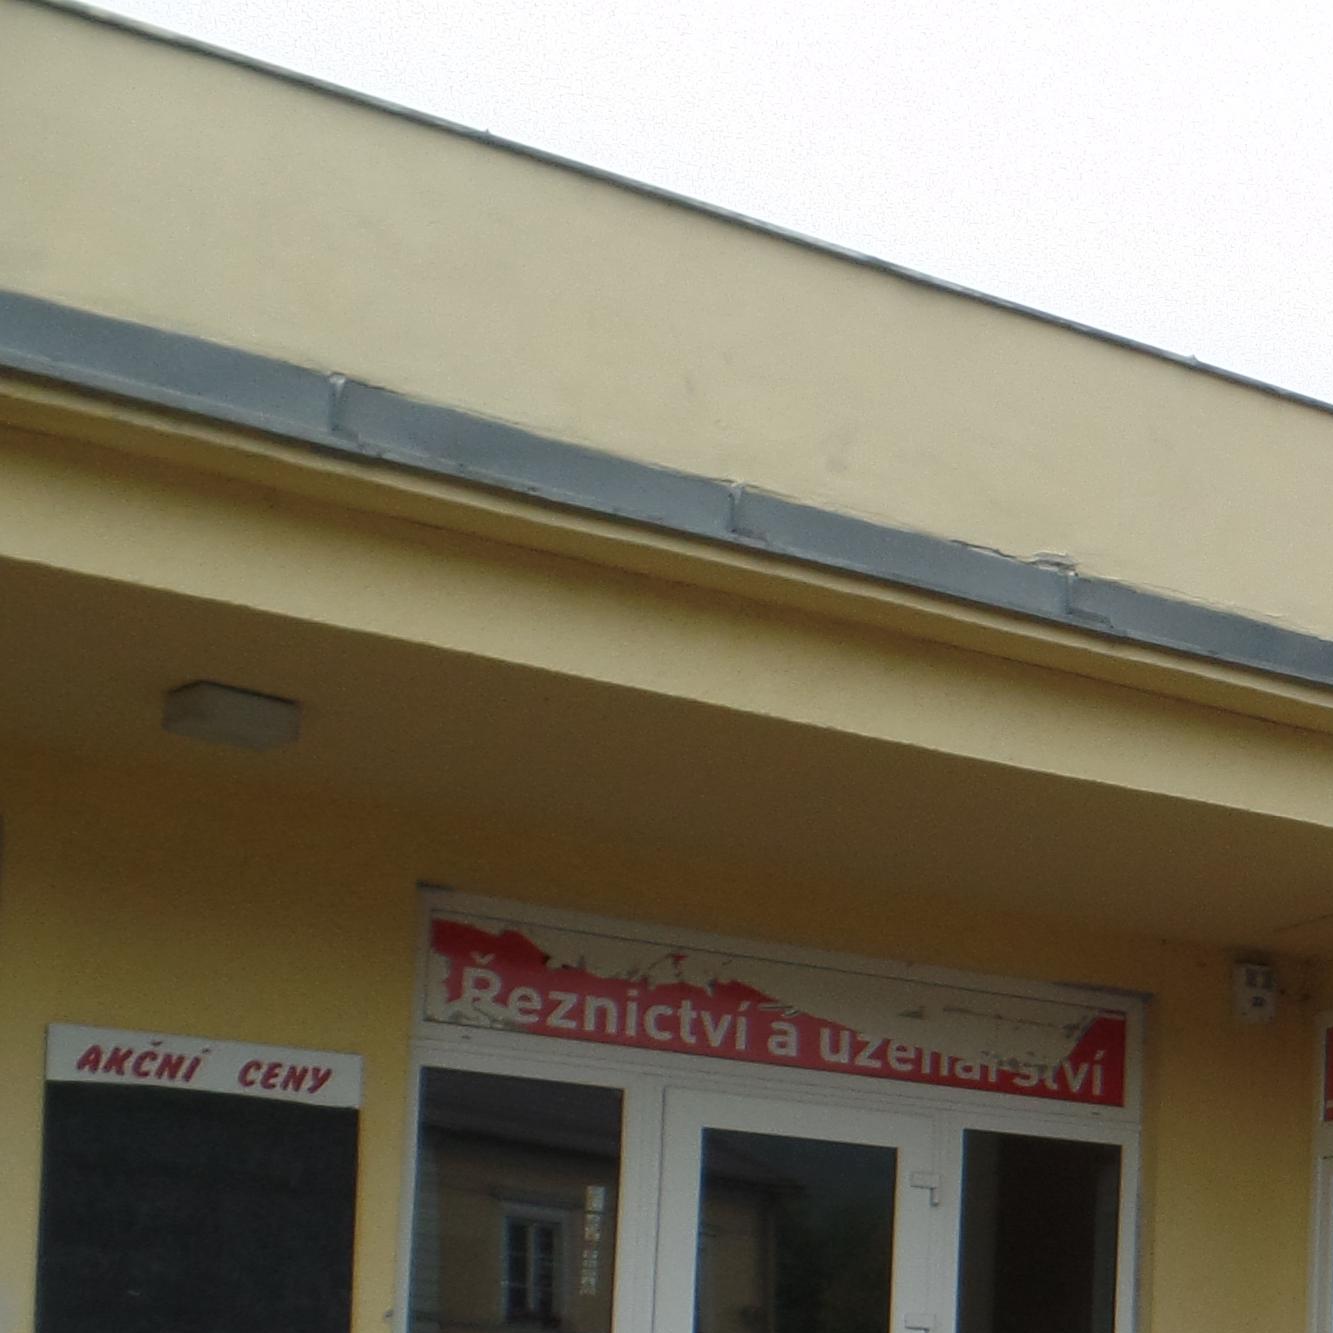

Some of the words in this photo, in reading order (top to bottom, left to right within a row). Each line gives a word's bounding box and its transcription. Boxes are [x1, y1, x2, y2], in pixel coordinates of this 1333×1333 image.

[460, 953, 748, 1052] Řeznictví
[76, 1041, 210, 1083] AKČNÍ
[237, 1060, 332, 1094] CENY
